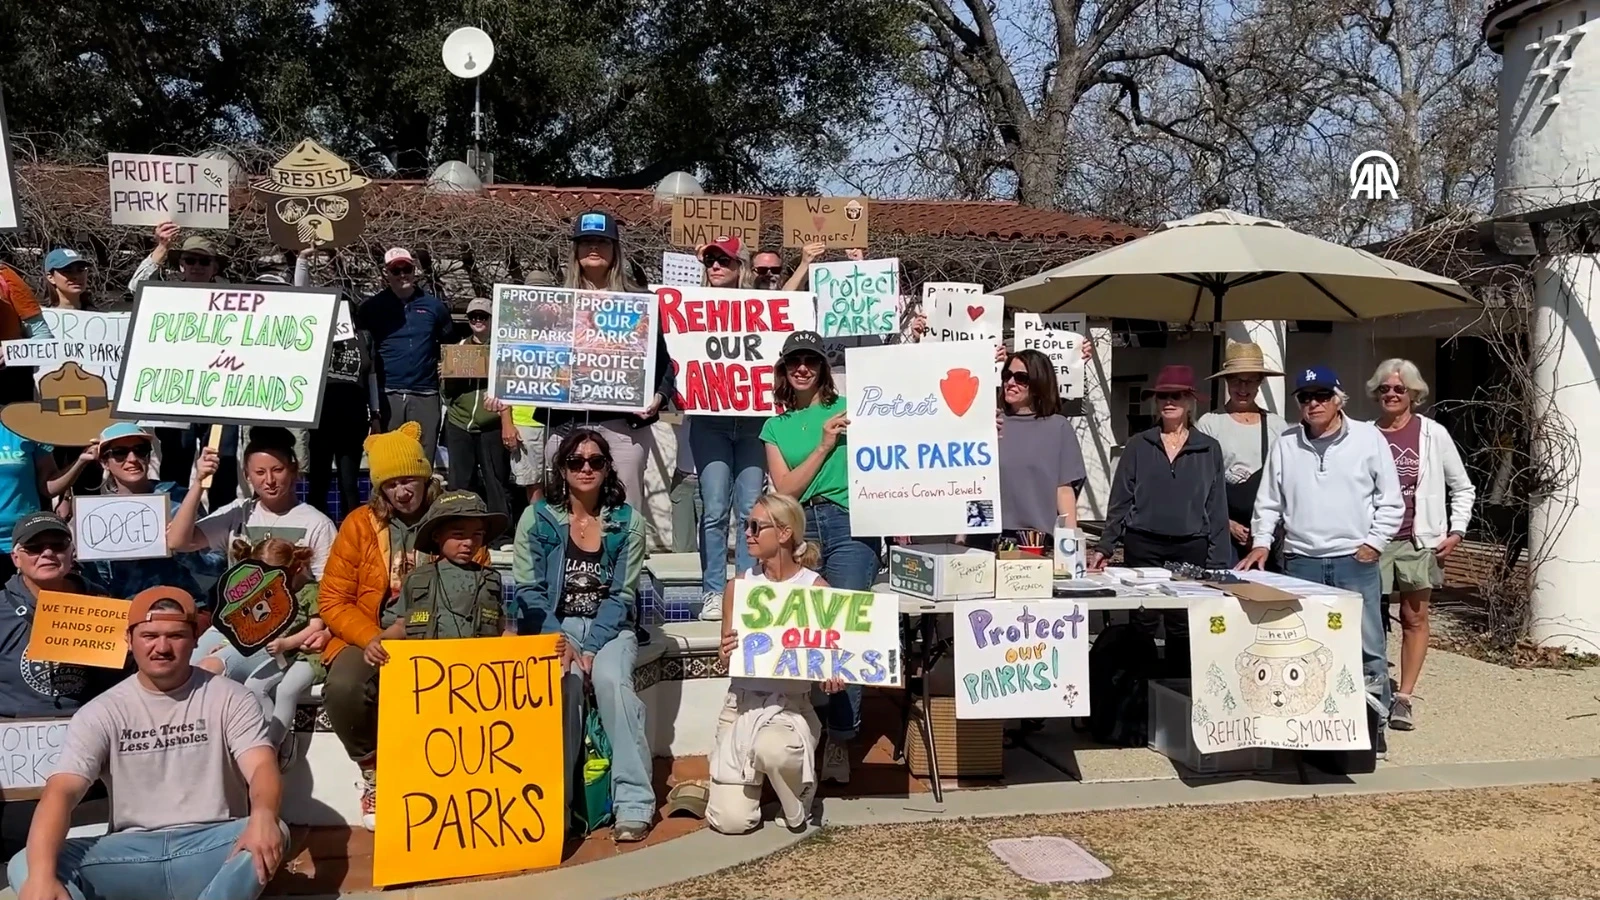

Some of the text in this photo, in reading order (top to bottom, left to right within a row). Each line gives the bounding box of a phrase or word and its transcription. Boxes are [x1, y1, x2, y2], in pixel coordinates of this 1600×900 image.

[112, 160, 222, 188] PROTECT OUR
[278, 167, 349, 188] RESIST
[114, 191, 228, 213] PARK STAFF
[683, 198, 758, 221] DEFEND
[806, 198, 835, 214] We
[793, 223, 856, 243] Rangers!
[815, 263, 898, 298] Protect
[208, 292, 265, 312] KEEP
[502, 289, 572, 304] #PROTECT
[594, 314, 631, 328] OUR
[656, 287, 794, 334] REHIRE
[149, 312, 238, 344] PUBLIC
[241, 314, 317, 351] LANDS
[498, 327, 574, 342] OUR PARKS
[823, 311, 896, 338] PARKS
[1025, 321, 1080, 331] PLANET
[586, 329, 639, 344] PARKS
[1025, 339, 1073, 349] PEOPLE
[7, 342, 58, 360] PROTECT
[64, 343, 84, 358] OUR
[706, 334, 764, 361] OUR
[209, 350, 244, 371] in
[515, 365, 552, 379] OUR
[590, 370, 627, 385] OUR
[134, 367, 220, 407] PUBLIC
[225, 372, 308, 412] HANDS
[506, 380, 561, 396] PARKS
[582, 384, 635, 400] PARKS
[856, 385, 938, 417] Protect
[856, 441, 992, 472] OUR PARKS
[911, 482, 945, 498] Crown
[89, 510, 153, 545] DOGE
[229, 570, 261, 599] RESIST
[42, 604, 60, 612] WE
[63, 605, 84, 615] THE
[741, 585, 874, 633] SAVE
[52, 621, 115, 634] HANDS OFF
[968, 604, 1085, 650] Protect
[45, 636, 115, 651] OUR PARKS!
[781, 627, 841, 649] OUR
[742, 633, 897, 684] PARKS!
[963, 646, 1058, 704] PARKS!
[120, 723, 194, 740] More Trees
[1205, 716, 1356, 745] REHIRE SMOKEY!
[119, 733, 208, 752] Less Assholes
[424, 720, 522, 778] OUR
[403, 783, 544, 851] PARKS
